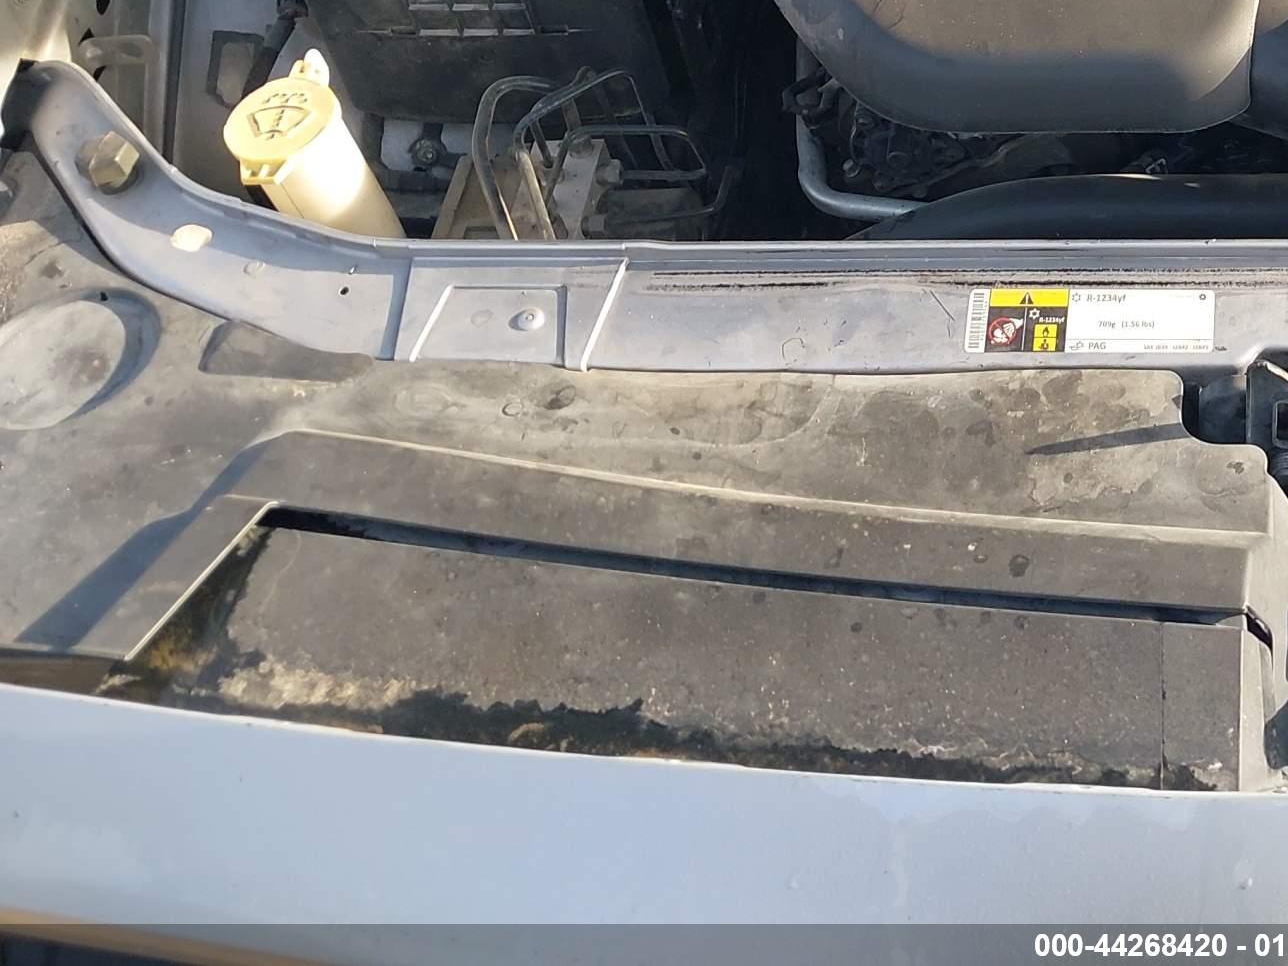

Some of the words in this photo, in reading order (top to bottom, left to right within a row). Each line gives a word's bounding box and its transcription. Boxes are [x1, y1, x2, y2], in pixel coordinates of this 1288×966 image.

[1086, 293, 1126, 303] R-1234yf
[1098, 320, 1116, 330] 709g
[1088, 341, 1107, 350] PAG
